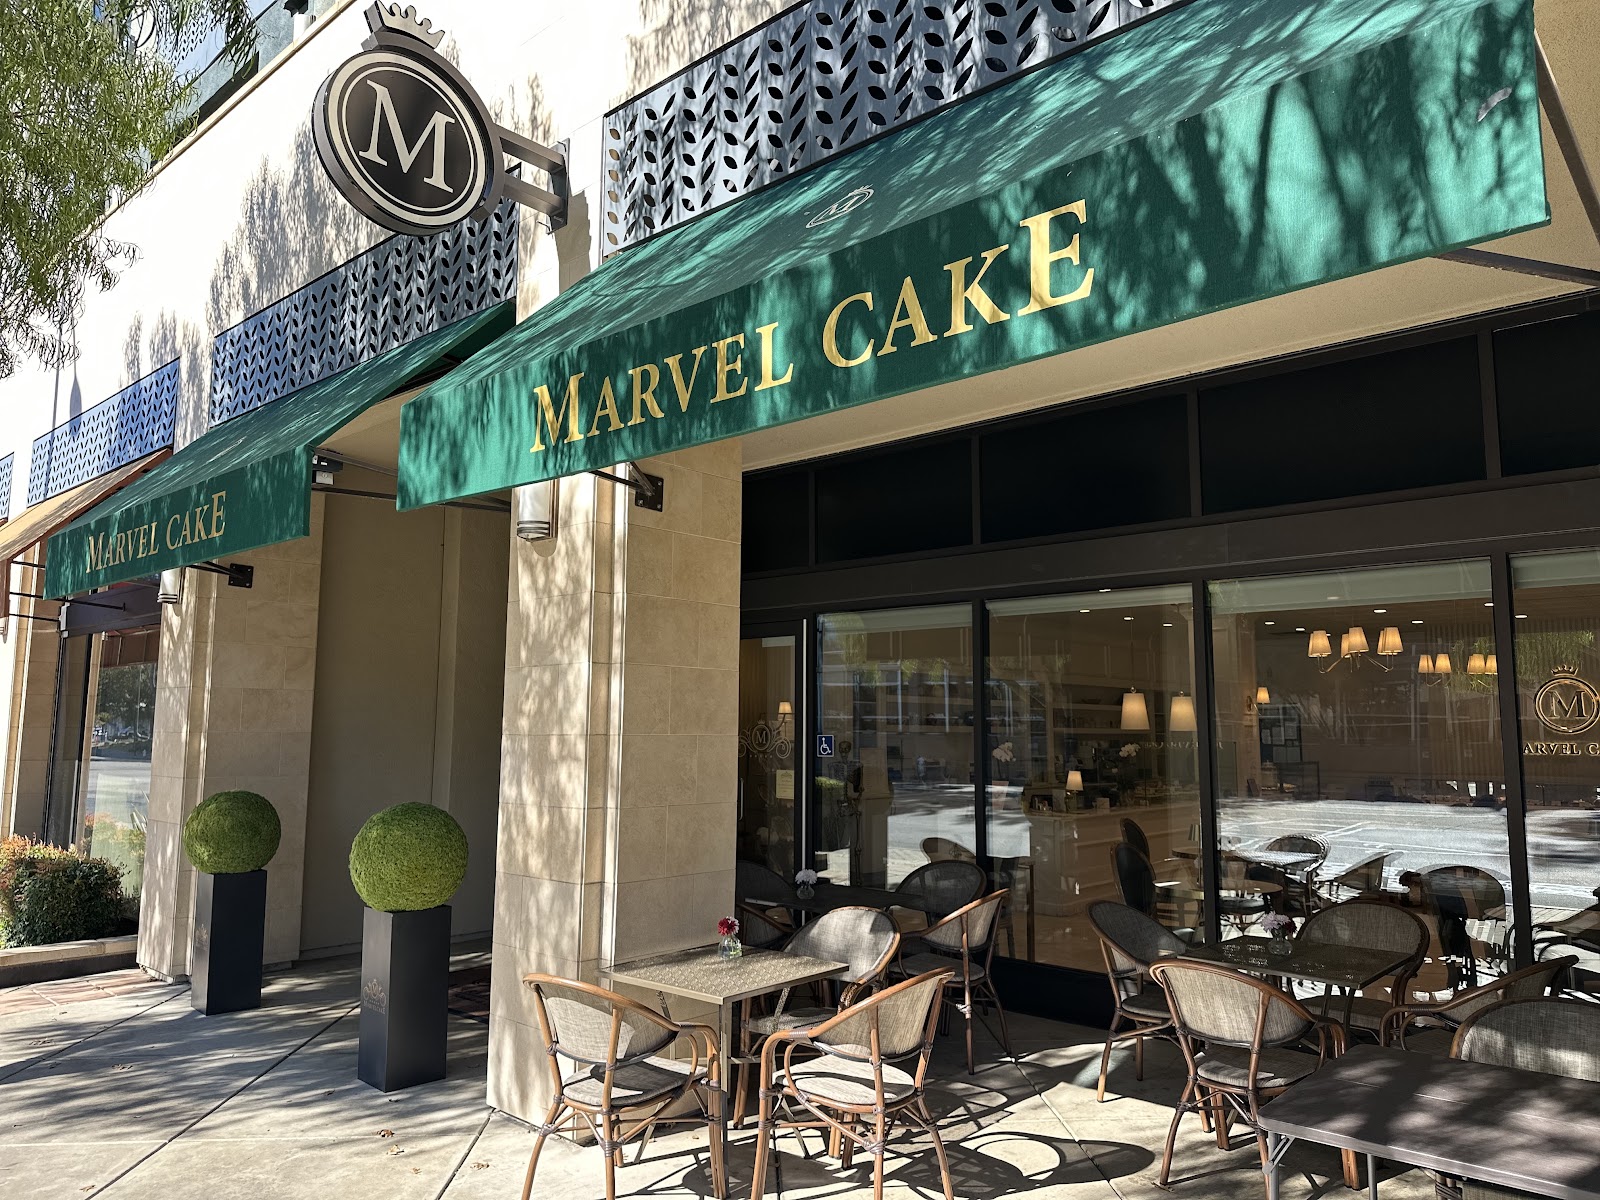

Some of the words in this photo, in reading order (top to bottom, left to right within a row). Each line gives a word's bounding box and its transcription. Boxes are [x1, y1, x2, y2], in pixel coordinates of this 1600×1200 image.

[359, 79, 455, 193] M
[530, 322, 794, 453] MARVEL
[822, 199, 1094, 367] CAKE
[86, 521, 160, 574] MARVEL
[166, 491, 226, 550] CAKE
[1547, 690, 1588, 719] M
[755, 730, 767, 744] M
[1523, 742, 1581, 756] ARVEL
